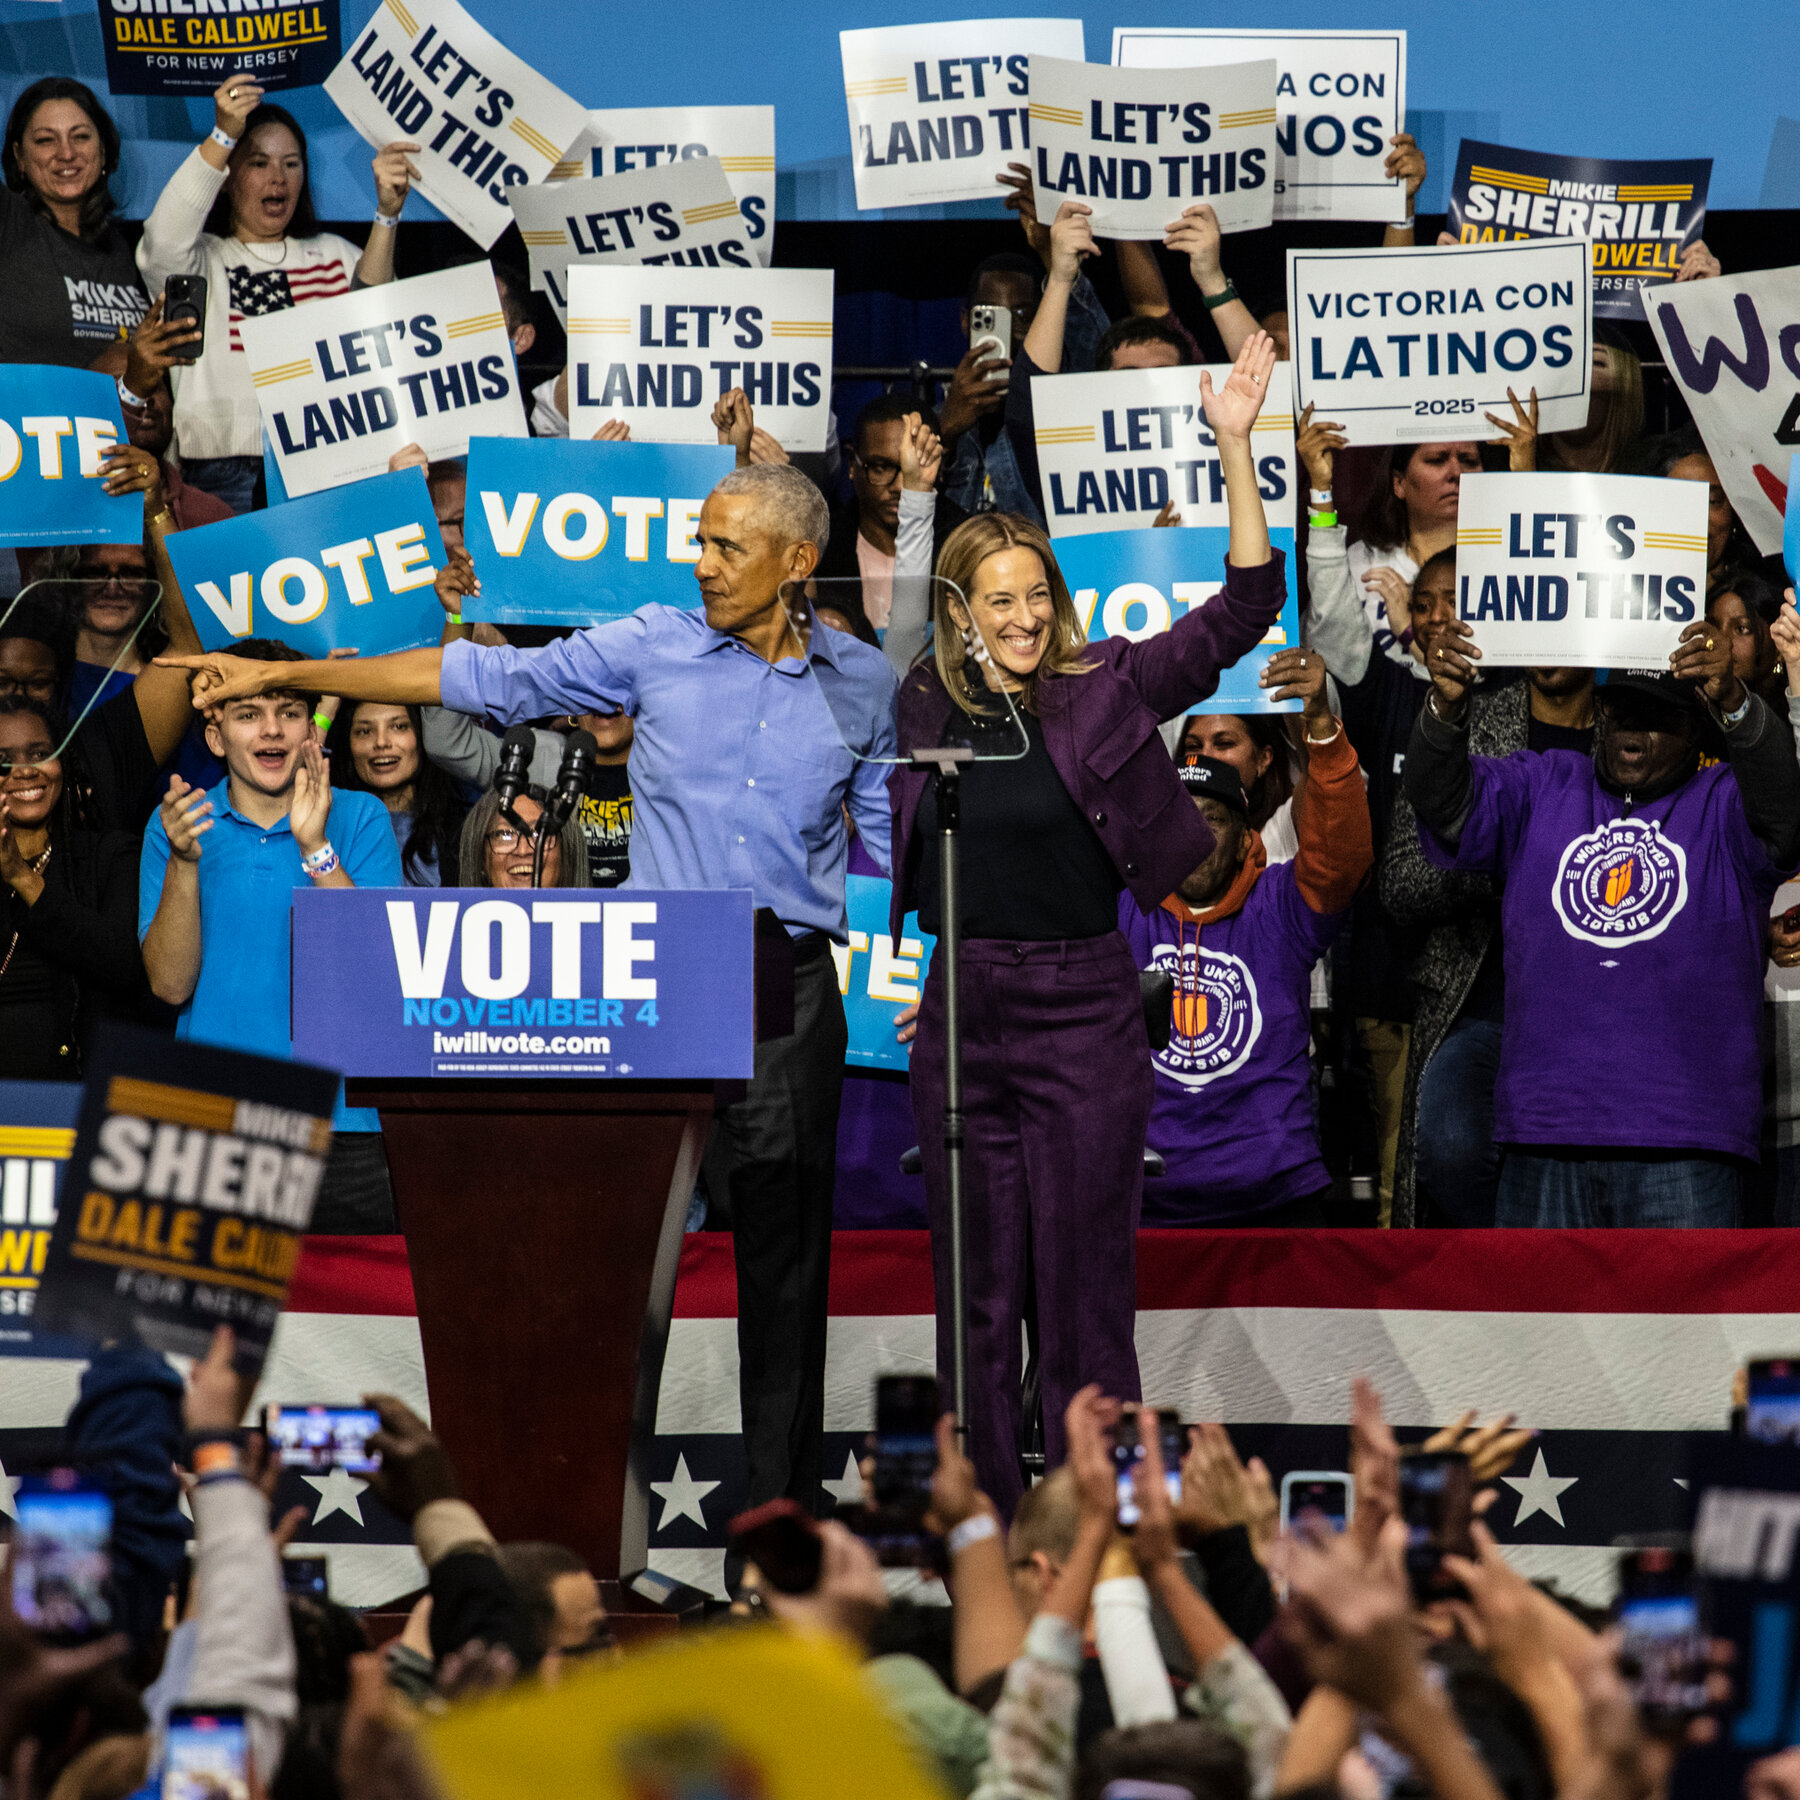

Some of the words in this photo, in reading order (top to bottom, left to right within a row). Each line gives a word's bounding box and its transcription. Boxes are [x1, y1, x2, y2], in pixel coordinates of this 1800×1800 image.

[114, 16, 178, 44] DALE
[186, 7, 327, 45] CALDWELL
[146, 54, 180, 69] FOR
[187, 55, 225, 70] NEW
[233, 49, 299, 70] JERSEY
[410, 24, 514, 128] LET'S
[914, 54, 1029, 103] LET'S
[1309, 73, 1385, 97] CON
[351, 29, 433, 135] LAND
[429, 110, 529, 206] THIS
[859, 115, 984, 167] LAND
[1090, 99, 1211, 145] LET'S
[1037, 147, 1151, 200] LAND
[1159, 148, 1266, 198] THIS
[1548, 180, 1618, 201] MIKIE
[566, 202, 680, 255] LET'S
[1464, 184, 1686, 239] SHERRILL
[1460, 223, 1530, 244] DA
[1592, 243, 1682, 269] DWELL
[64, 276, 150, 310] MIKIE
[1307, 288, 1484, 318] VICTORIA
[1496, 281, 1573, 310] CON
[1592, 277, 1648, 291] ERSEY
[71, 303, 146, 327] SHERRI
[73, 329, 115, 340] GOVERNOR
[640, 304, 764, 349] LET'S
[315, 314, 442, 383] LET'S
[1311, 325, 1573, 380] LATINOS
[273, 386, 398, 456] LAND
[398, 355, 510, 418] THIS
[576, 363, 702, 408] LAND
[711, 361, 821, 408] THIS
[1415, 399, 1475, 416] 2025
[0, 416, 118, 482] TE
[1049, 467, 1169, 515] LAND
[1176, 456, 1287, 504] THS
[480, 491, 702, 562] VOTE
[1509, 513, 1636, 560] LET'S
[195, 522, 437, 638] VOTE
[1460, 575, 1568, 621] LAND
[1577, 572, 1695, 622] THIS
[1072, 582, 1287, 645] OT
[1178, 765, 1212, 777] orkers
[1180, 773, 1207, 781] nited
[583, 795, 619, 819] KIE
[1573, 831, 1635, 865] WOERS
[1640, 830, 1670, 868] NITED
[386, 900, 657, 1000] VOTE
[830, 930, 924, 1004] TE
[1203, 964, 1242, 994] UNED
[403, 998, 625, 1026] NOVEMBER
[635, 1001, 659, 1027] 4
[433, 1032, 611, 1054] iwillvote.com
[76, 1192, 202, 1262] DALE
